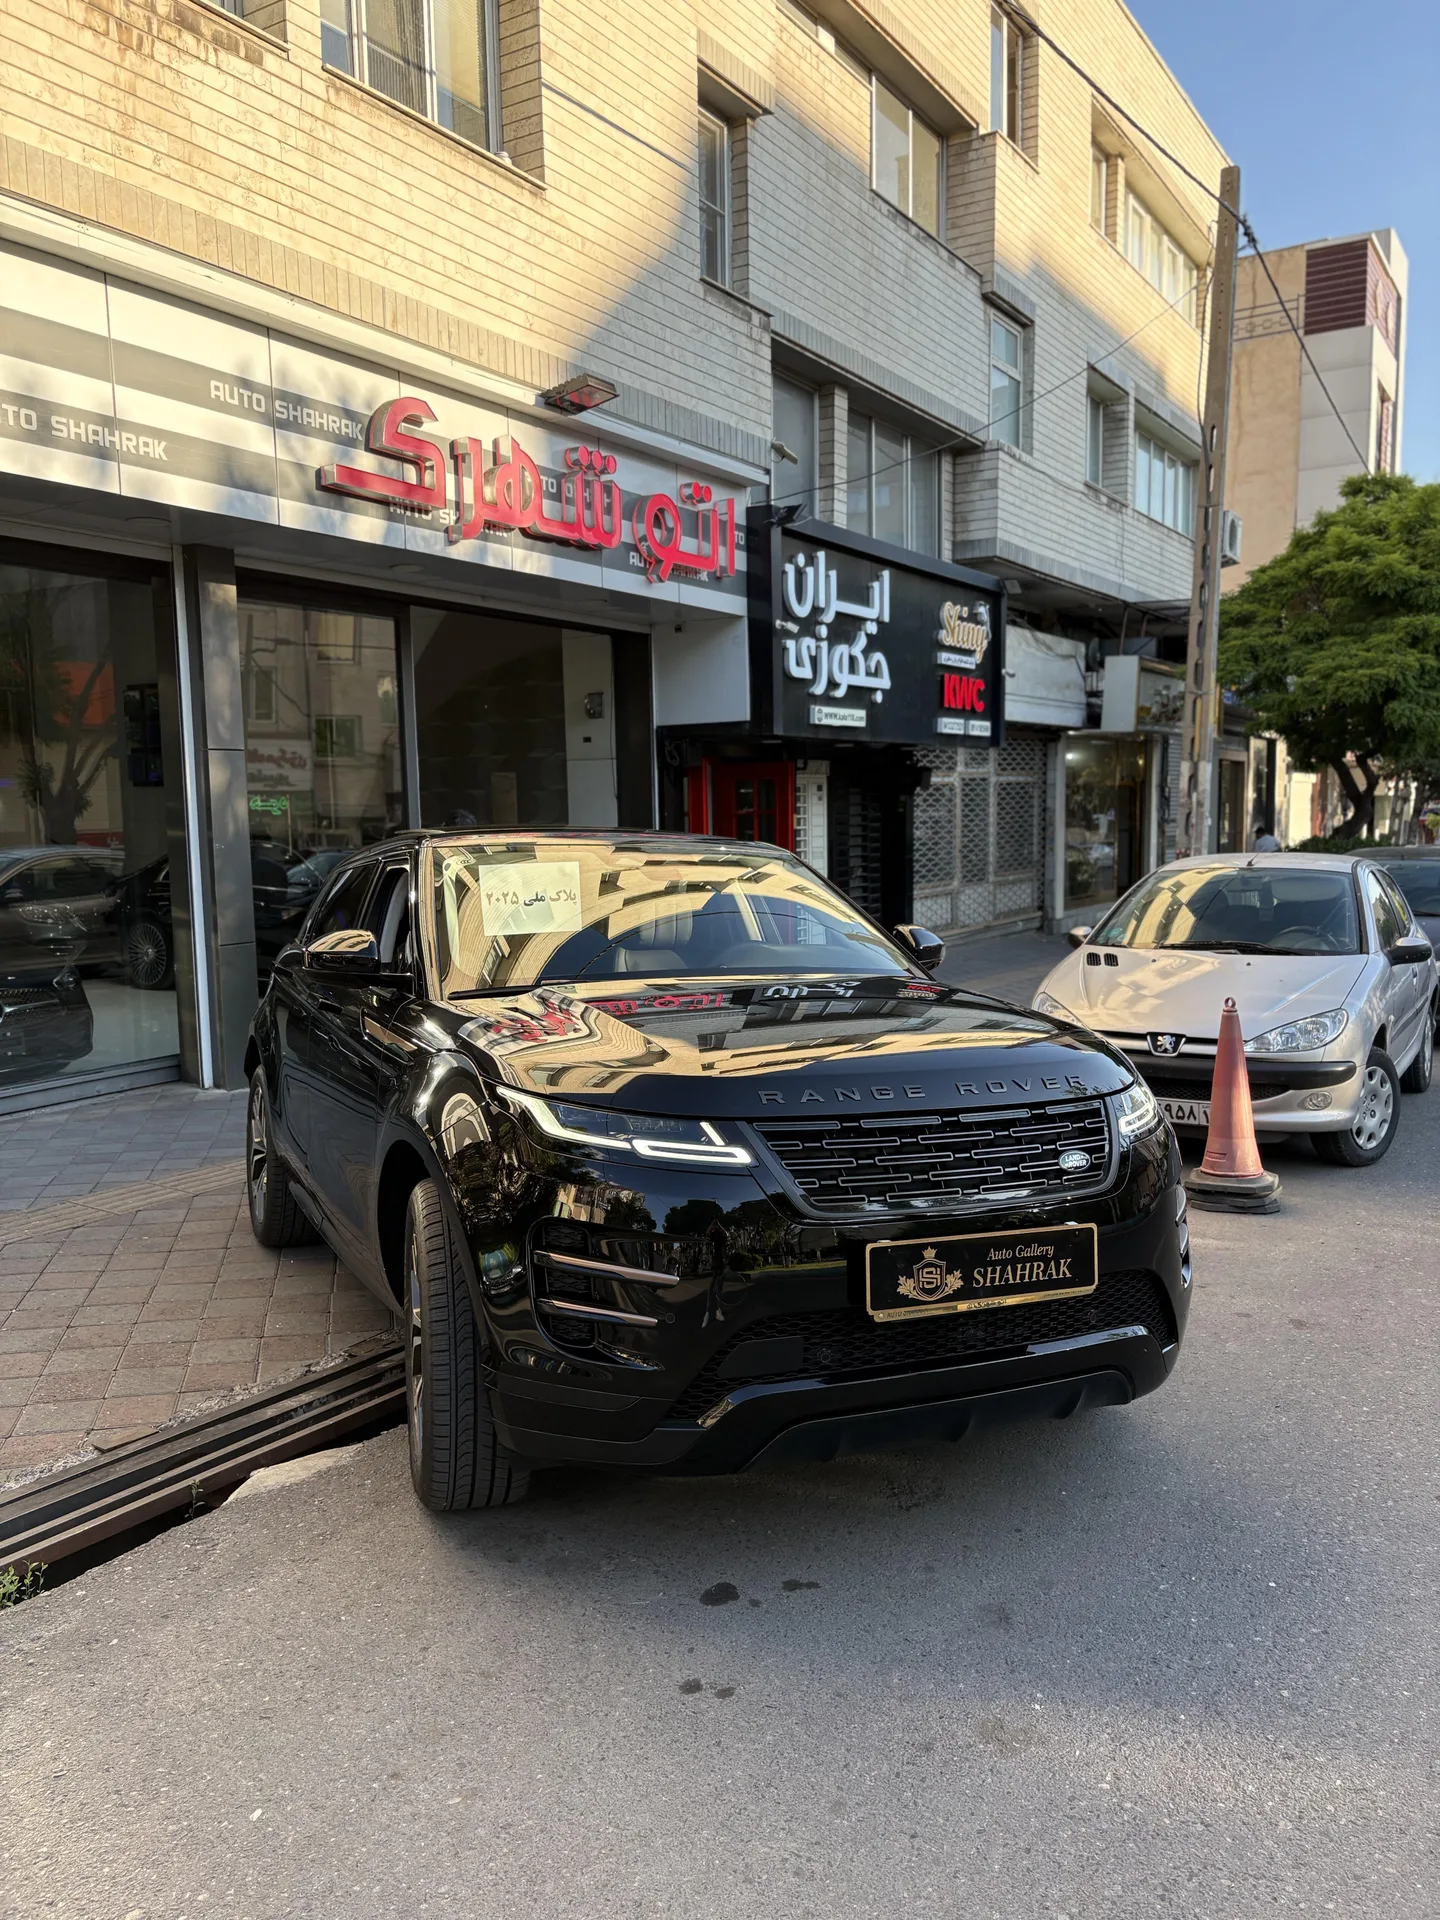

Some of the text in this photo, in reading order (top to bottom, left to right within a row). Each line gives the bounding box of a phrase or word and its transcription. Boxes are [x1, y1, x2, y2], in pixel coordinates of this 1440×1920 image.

[210, 380, 363, 441] AUTO SHAHRAK
[0, 403, 168, 461] TO SHAHRAK
[316, 396, 622, 550] شهرک
[783, 551, 890, 634] ایران
[941, 601, 988, 664] Shiny
[783, 624, 891, 704] جکوزی
[943, 672, 985, 713] KWC
[485, 888, 577, 906] پلاک ملی ۲۰۲۵
[757, 1074, 1087, 1105] RANGE ROVER
[1065, 1154, 1080, 1162] LAND
[1068, 1159, 1087, 1168] ROVER
[986, 1243, 1054, 1261] Auto Gallery
[972, 1258, 1073, 1288] SHAHRAK
